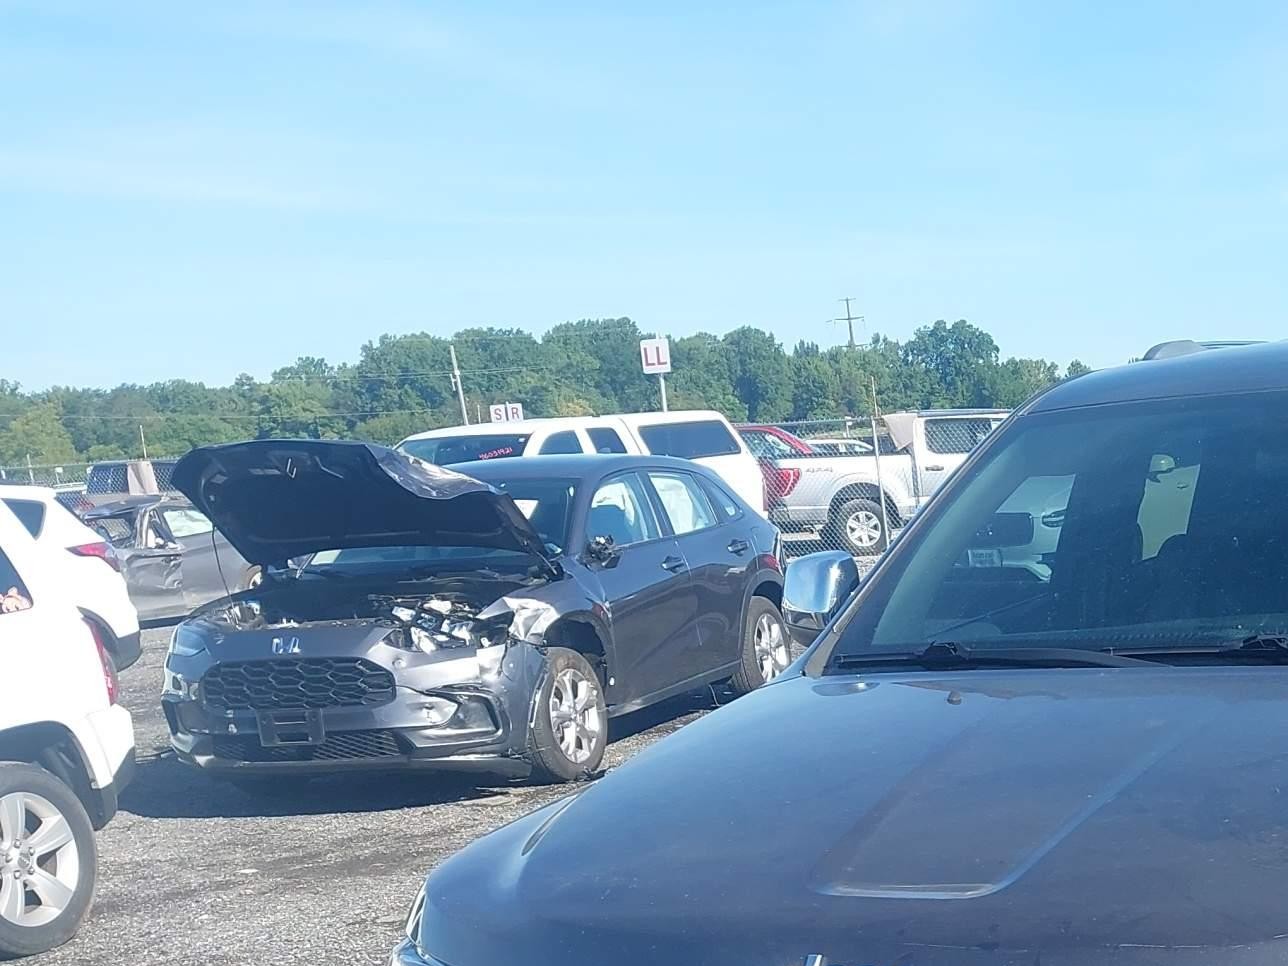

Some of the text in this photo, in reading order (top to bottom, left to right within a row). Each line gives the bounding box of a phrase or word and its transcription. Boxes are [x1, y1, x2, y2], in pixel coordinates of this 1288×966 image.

[643, 346, 667, 366] LL
[494, 408, 502, 420] S
[511, 407, 519, 419] R
